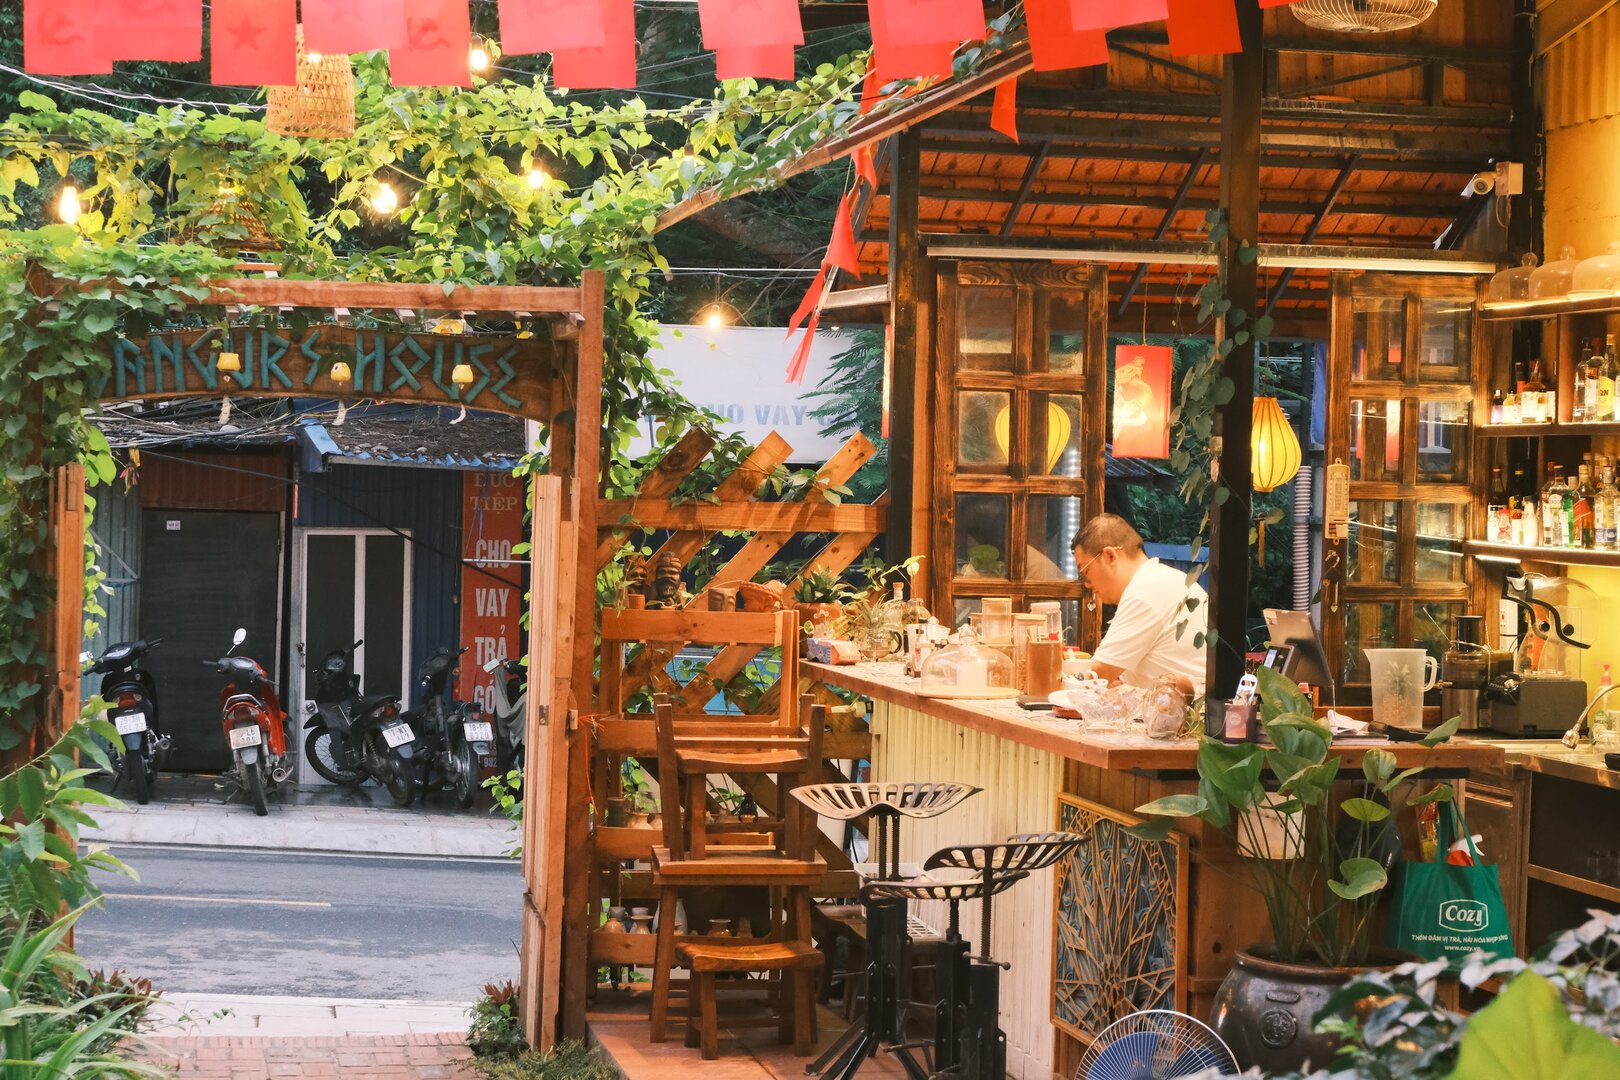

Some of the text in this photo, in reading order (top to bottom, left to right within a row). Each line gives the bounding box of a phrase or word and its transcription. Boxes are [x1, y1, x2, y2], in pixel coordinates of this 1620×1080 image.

[698, 403, 744, 425] HO
[754, 404, 807, 425] VAY
[475, 539, 511, 569] CHO
[475, 588, 510, 617] VAY
[474, 624, 508, 666] TRẢ
[473, 679, 498, 715] GÓ
[1445, 905, 1482, 927] Cozy
